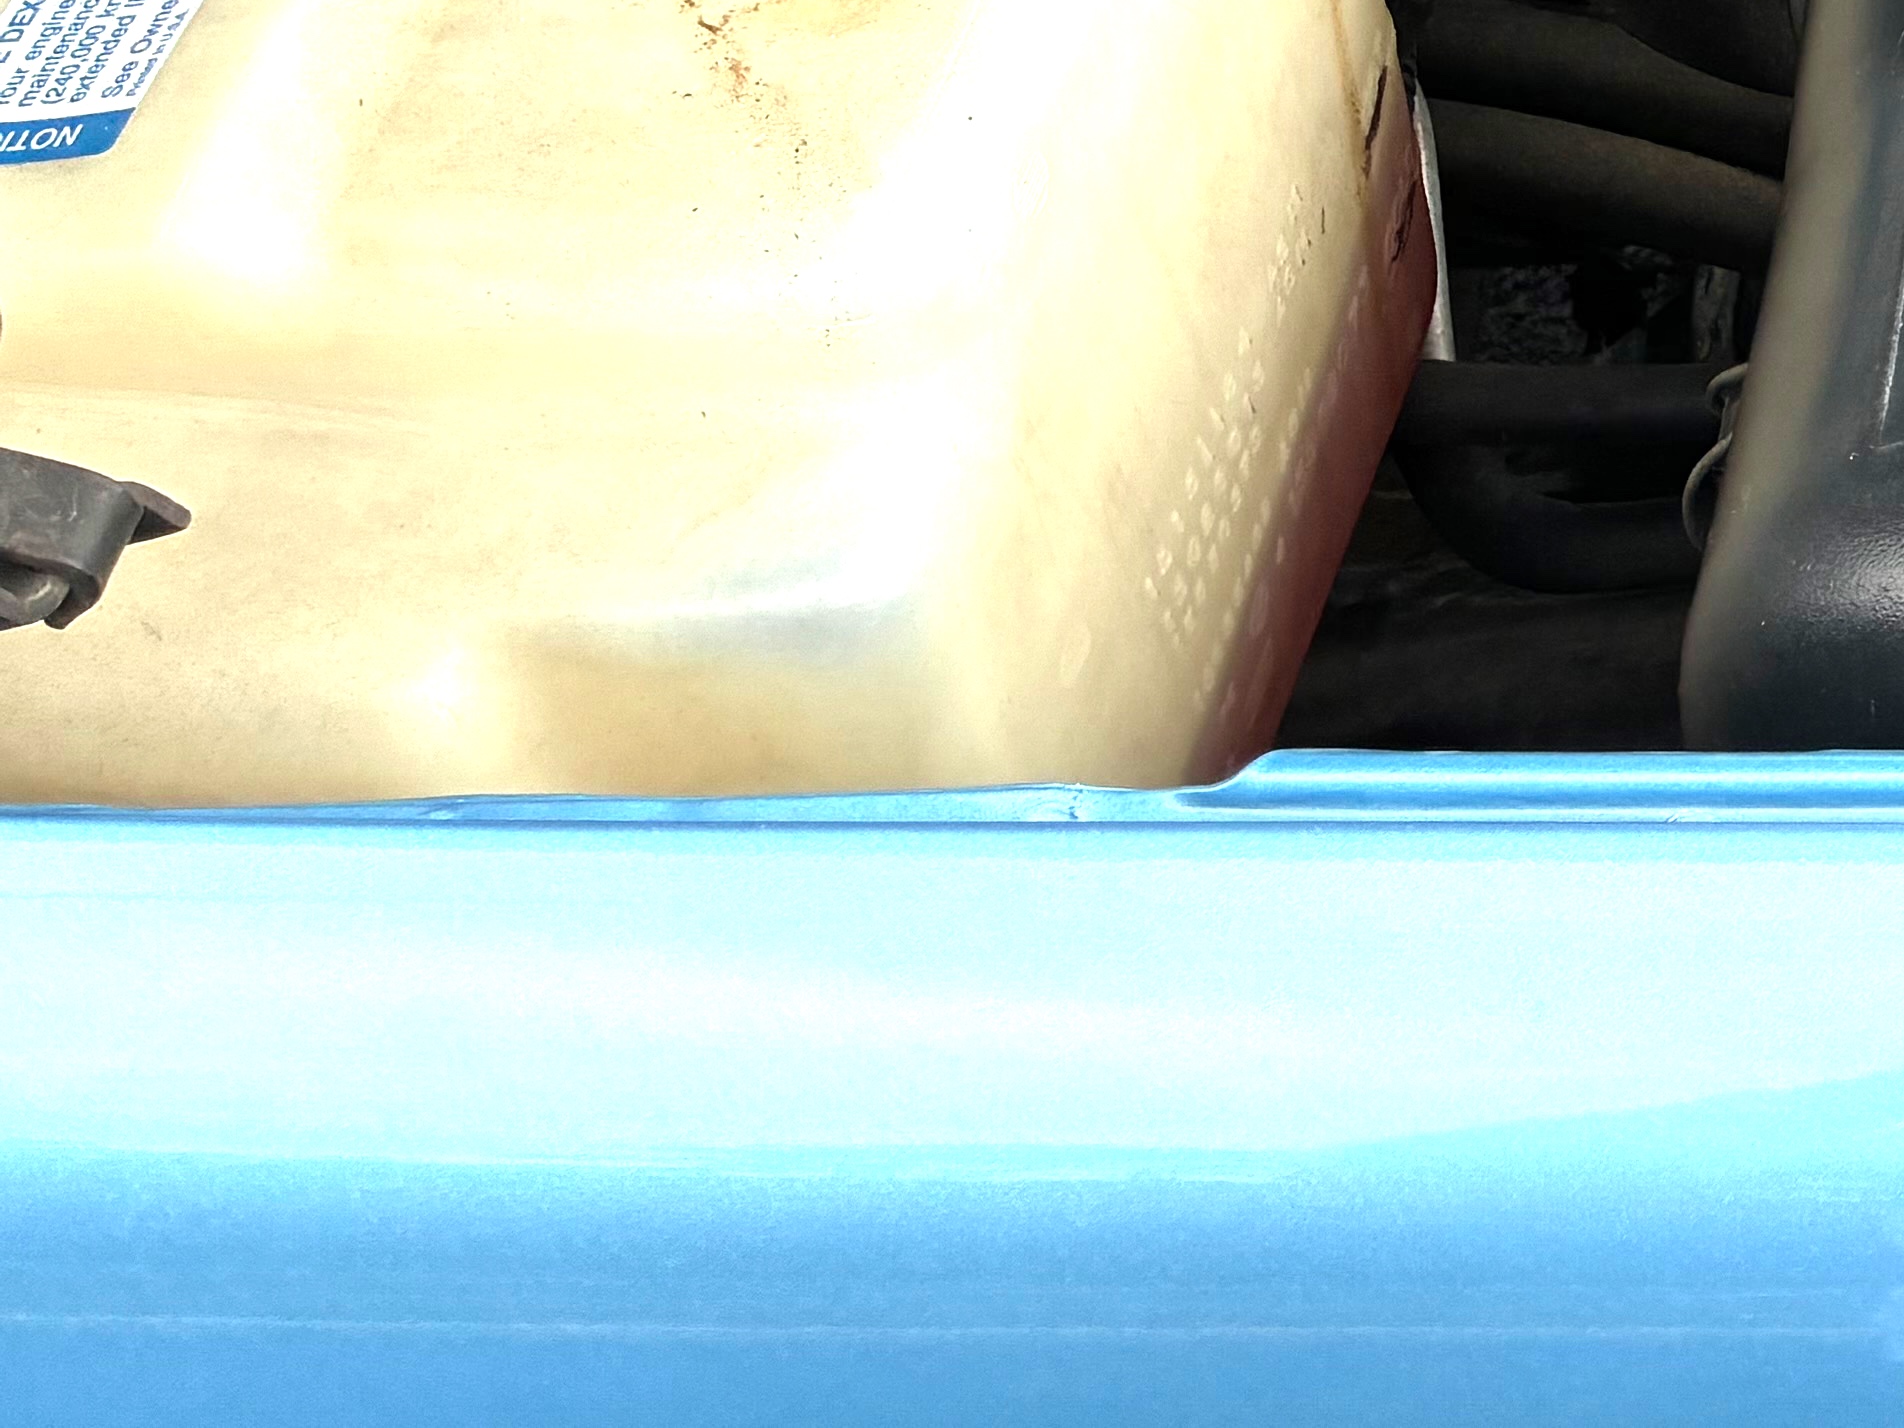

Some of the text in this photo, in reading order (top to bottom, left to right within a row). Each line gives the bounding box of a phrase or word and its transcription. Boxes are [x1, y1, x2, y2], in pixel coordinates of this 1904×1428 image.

[40, 23, 106, 104] (240,000
[69, 13, 136, 103] extended
[100, 59, 139, 98] See
[0, 124, 83, 151] NOTI
